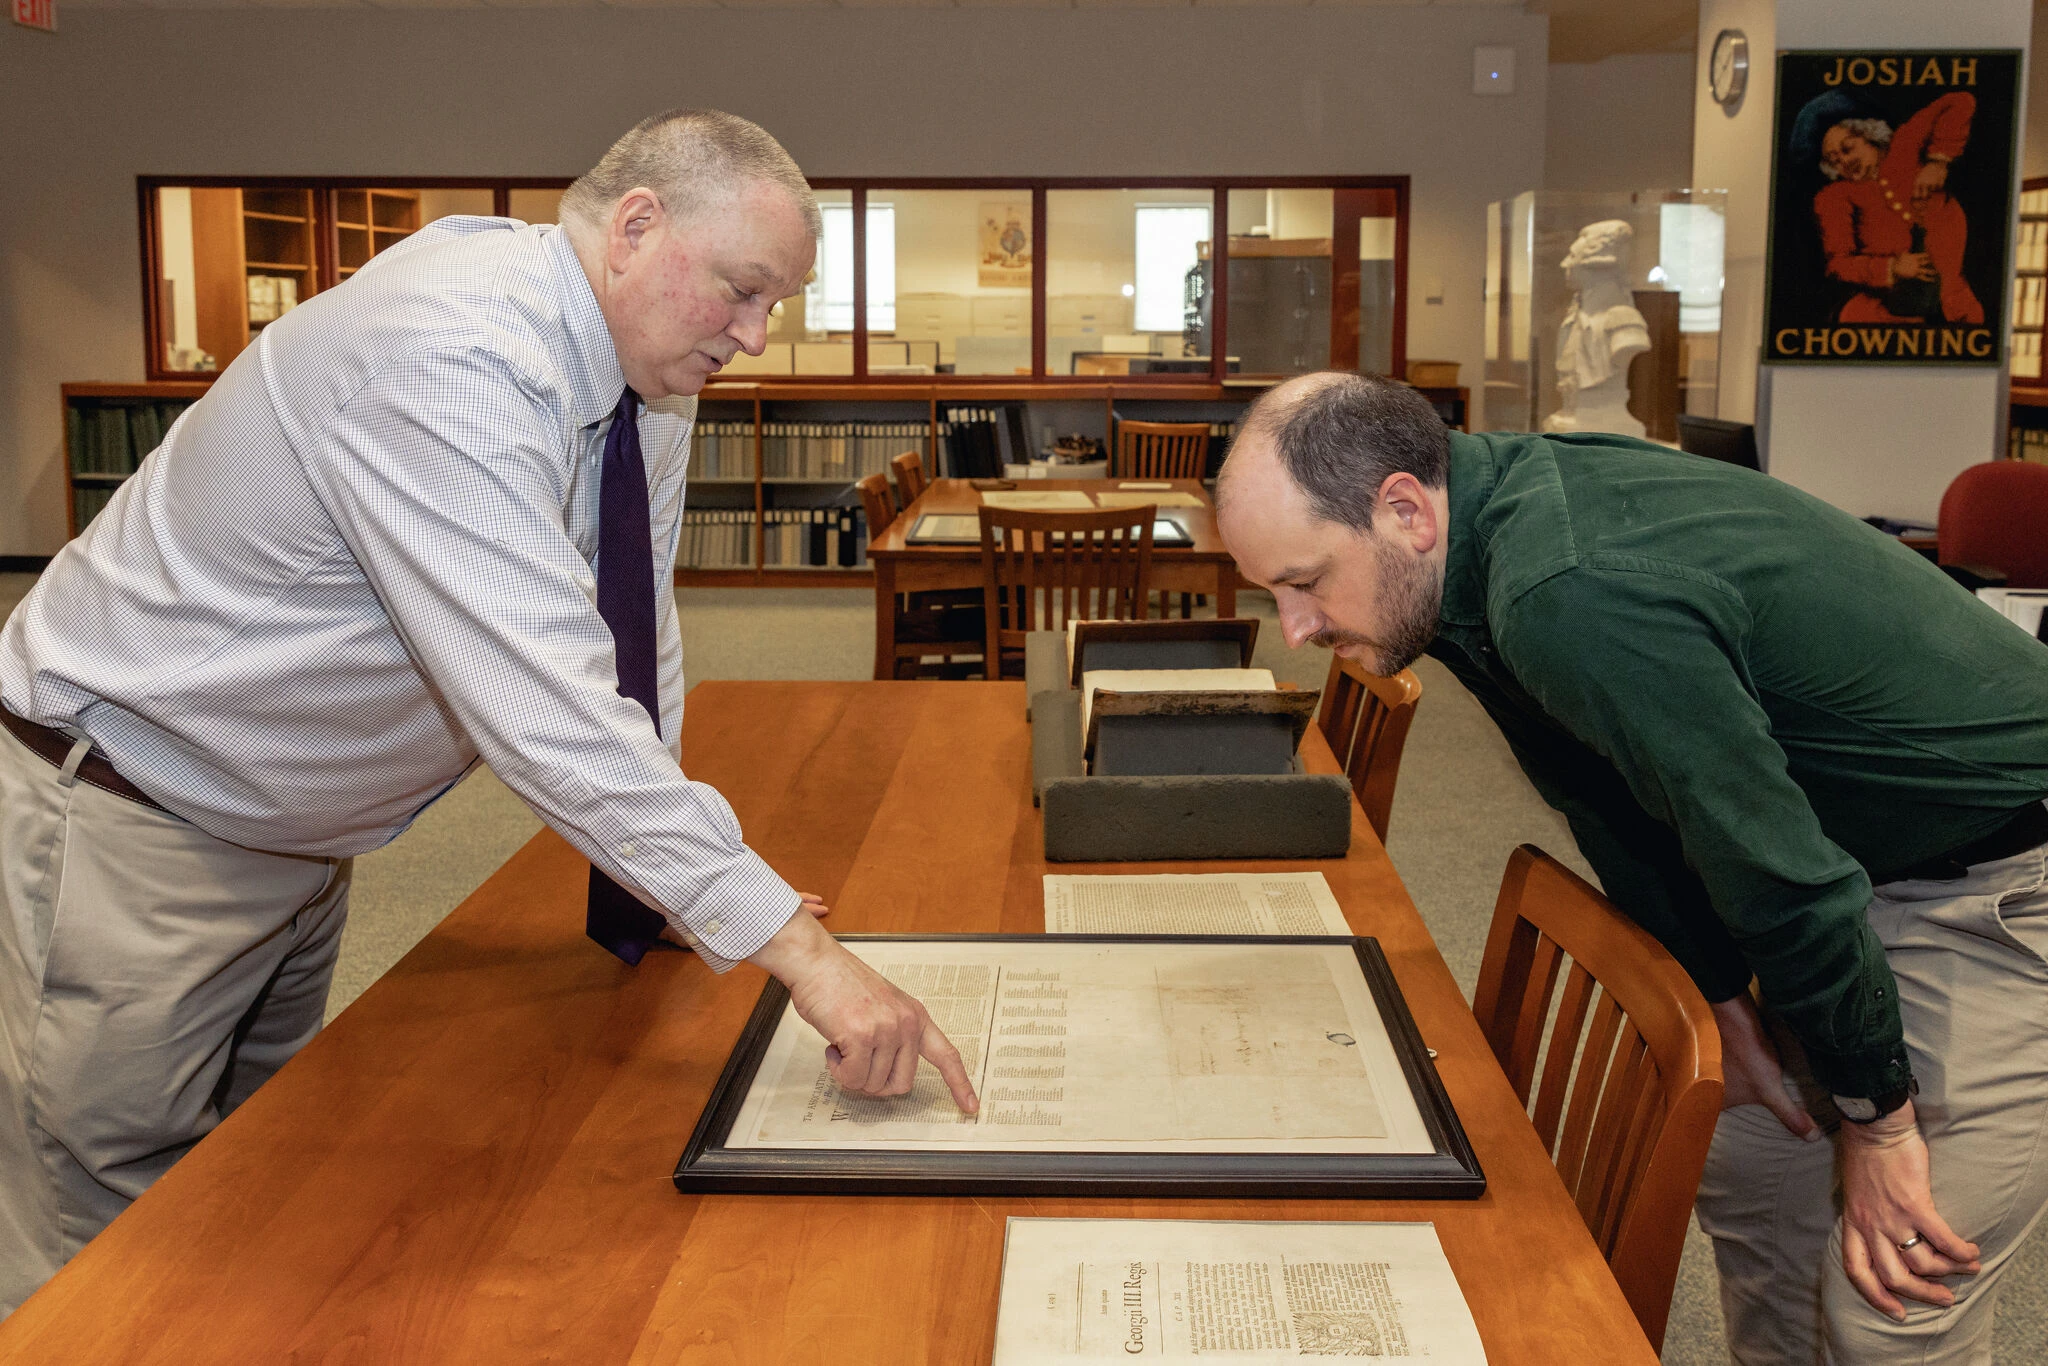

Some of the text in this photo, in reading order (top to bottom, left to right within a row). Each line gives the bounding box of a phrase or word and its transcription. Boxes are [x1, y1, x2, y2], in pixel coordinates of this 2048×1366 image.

[1824, 58, 1979, 86] JOSIAH
[1775, 328, 1993, 357] CHOWNING
[1123, 1310, 1148, 1354] Georgii
